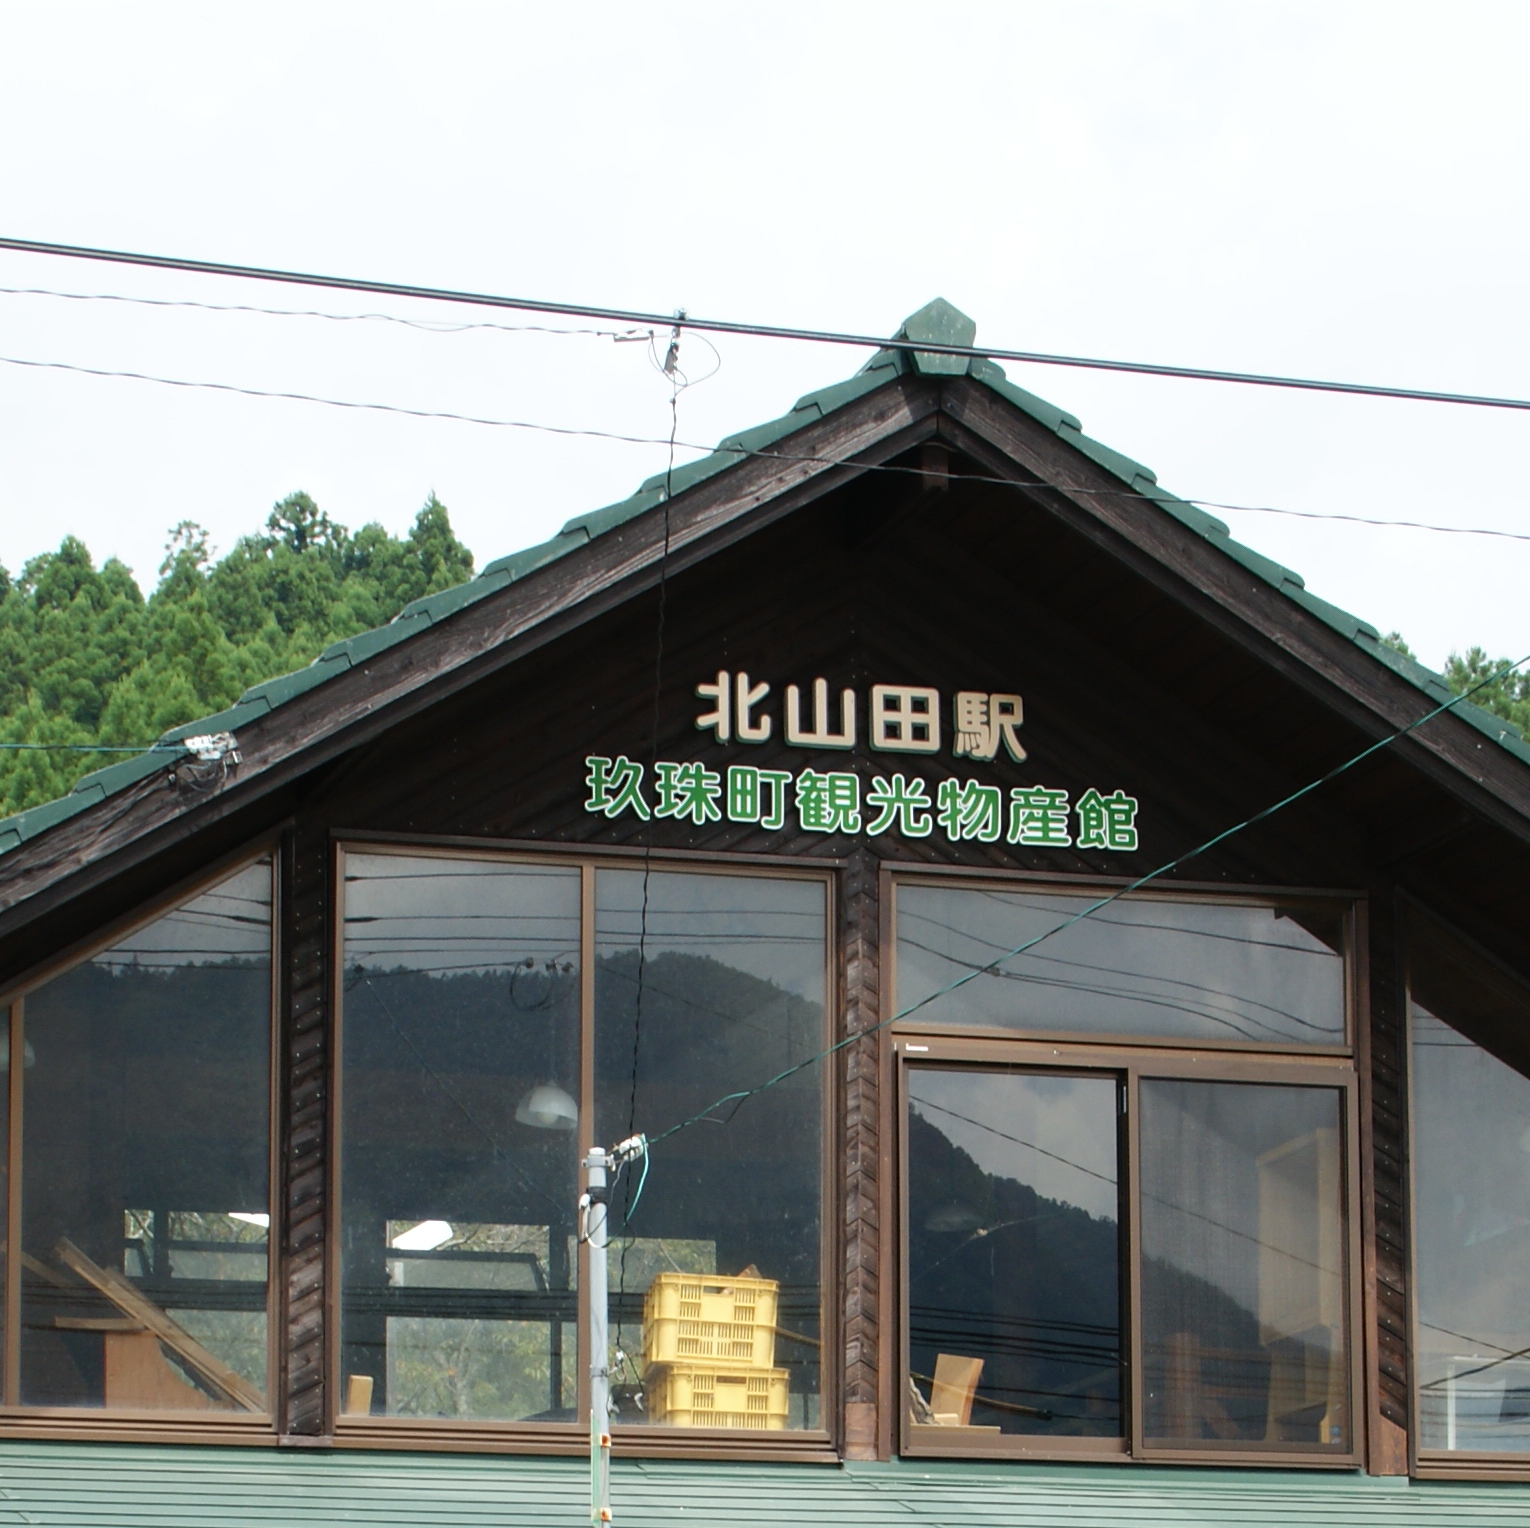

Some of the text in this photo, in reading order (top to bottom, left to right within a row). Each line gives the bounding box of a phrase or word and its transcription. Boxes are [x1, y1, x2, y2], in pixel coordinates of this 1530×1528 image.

[695, 670, 1028, 763] 北山田駅
[584, 754, 1139, 852] 玖珠町観光物産館
